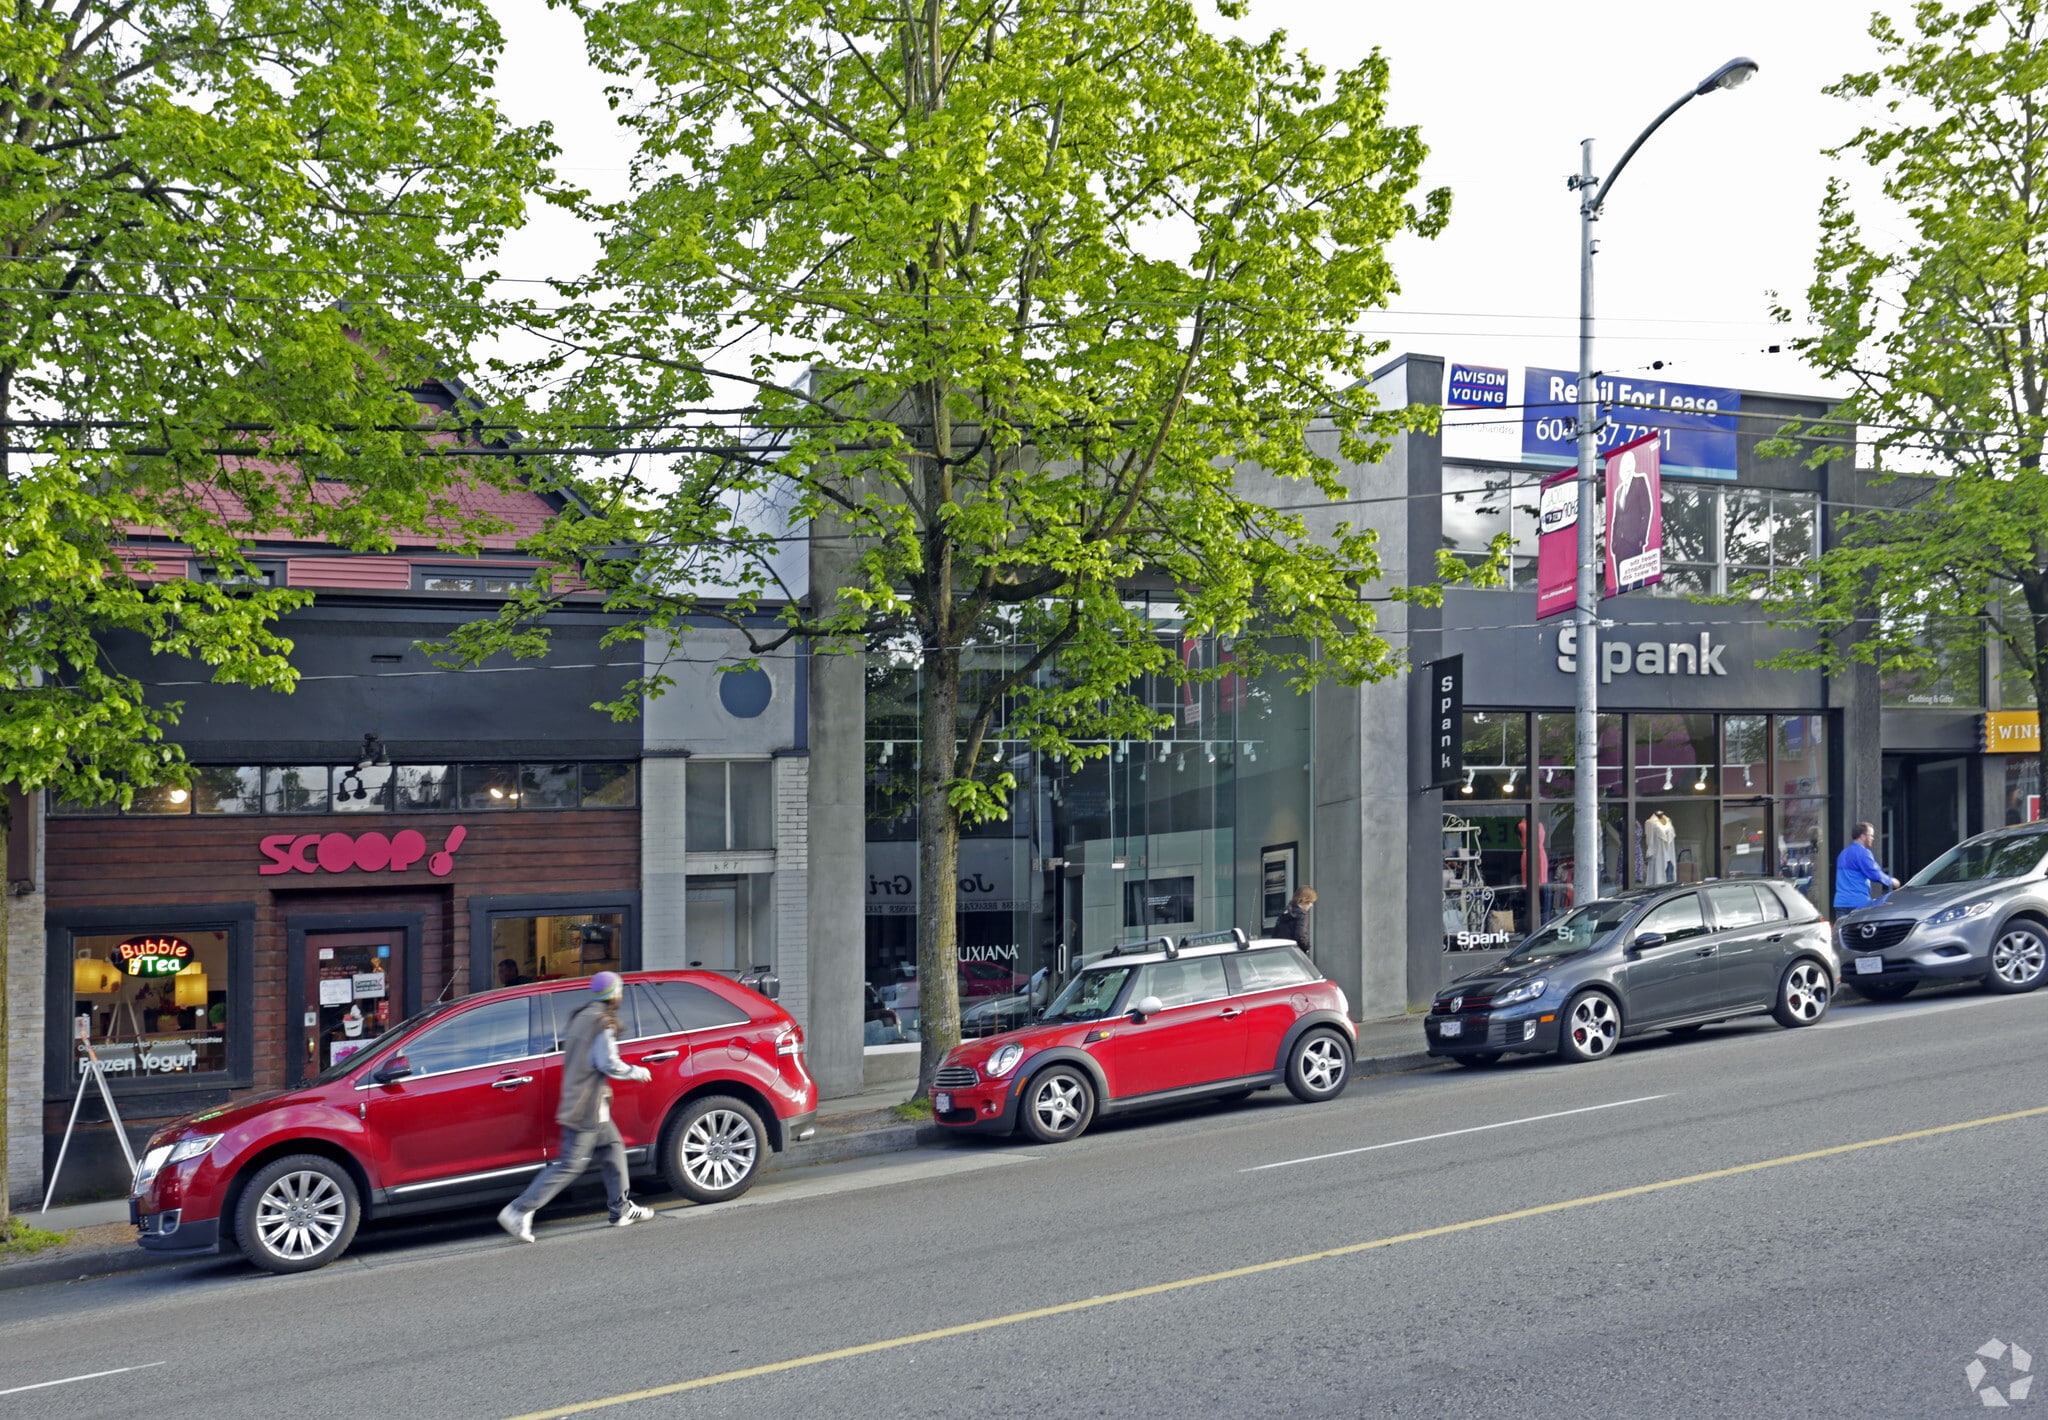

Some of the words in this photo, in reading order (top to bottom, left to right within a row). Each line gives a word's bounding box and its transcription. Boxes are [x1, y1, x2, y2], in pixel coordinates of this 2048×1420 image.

[1453, 370, 1506, 386] AVISON
[1452, 388, 1504, 403] YOUNG
[1549, 376, 1614, 404] Reil
[1619, 384, 1655, 411] For
[1659, 388, 1718, 417] Lease
[1557, 626, 1728, 684] Spank
[1441, 675, 1453, 768] Spank
[1457, 929, 1510, 948] Spank
[120, 939, 187, 959] Bubble
[957, 944, 1016, 961] UXIANA
[142, 956, 181, 972] Tea
[152, 1038, 186, 1048] Chocolate
[191, 1036, 223, 1045] Smoothies
[139, 1050, 198, 1071] Yogurt
